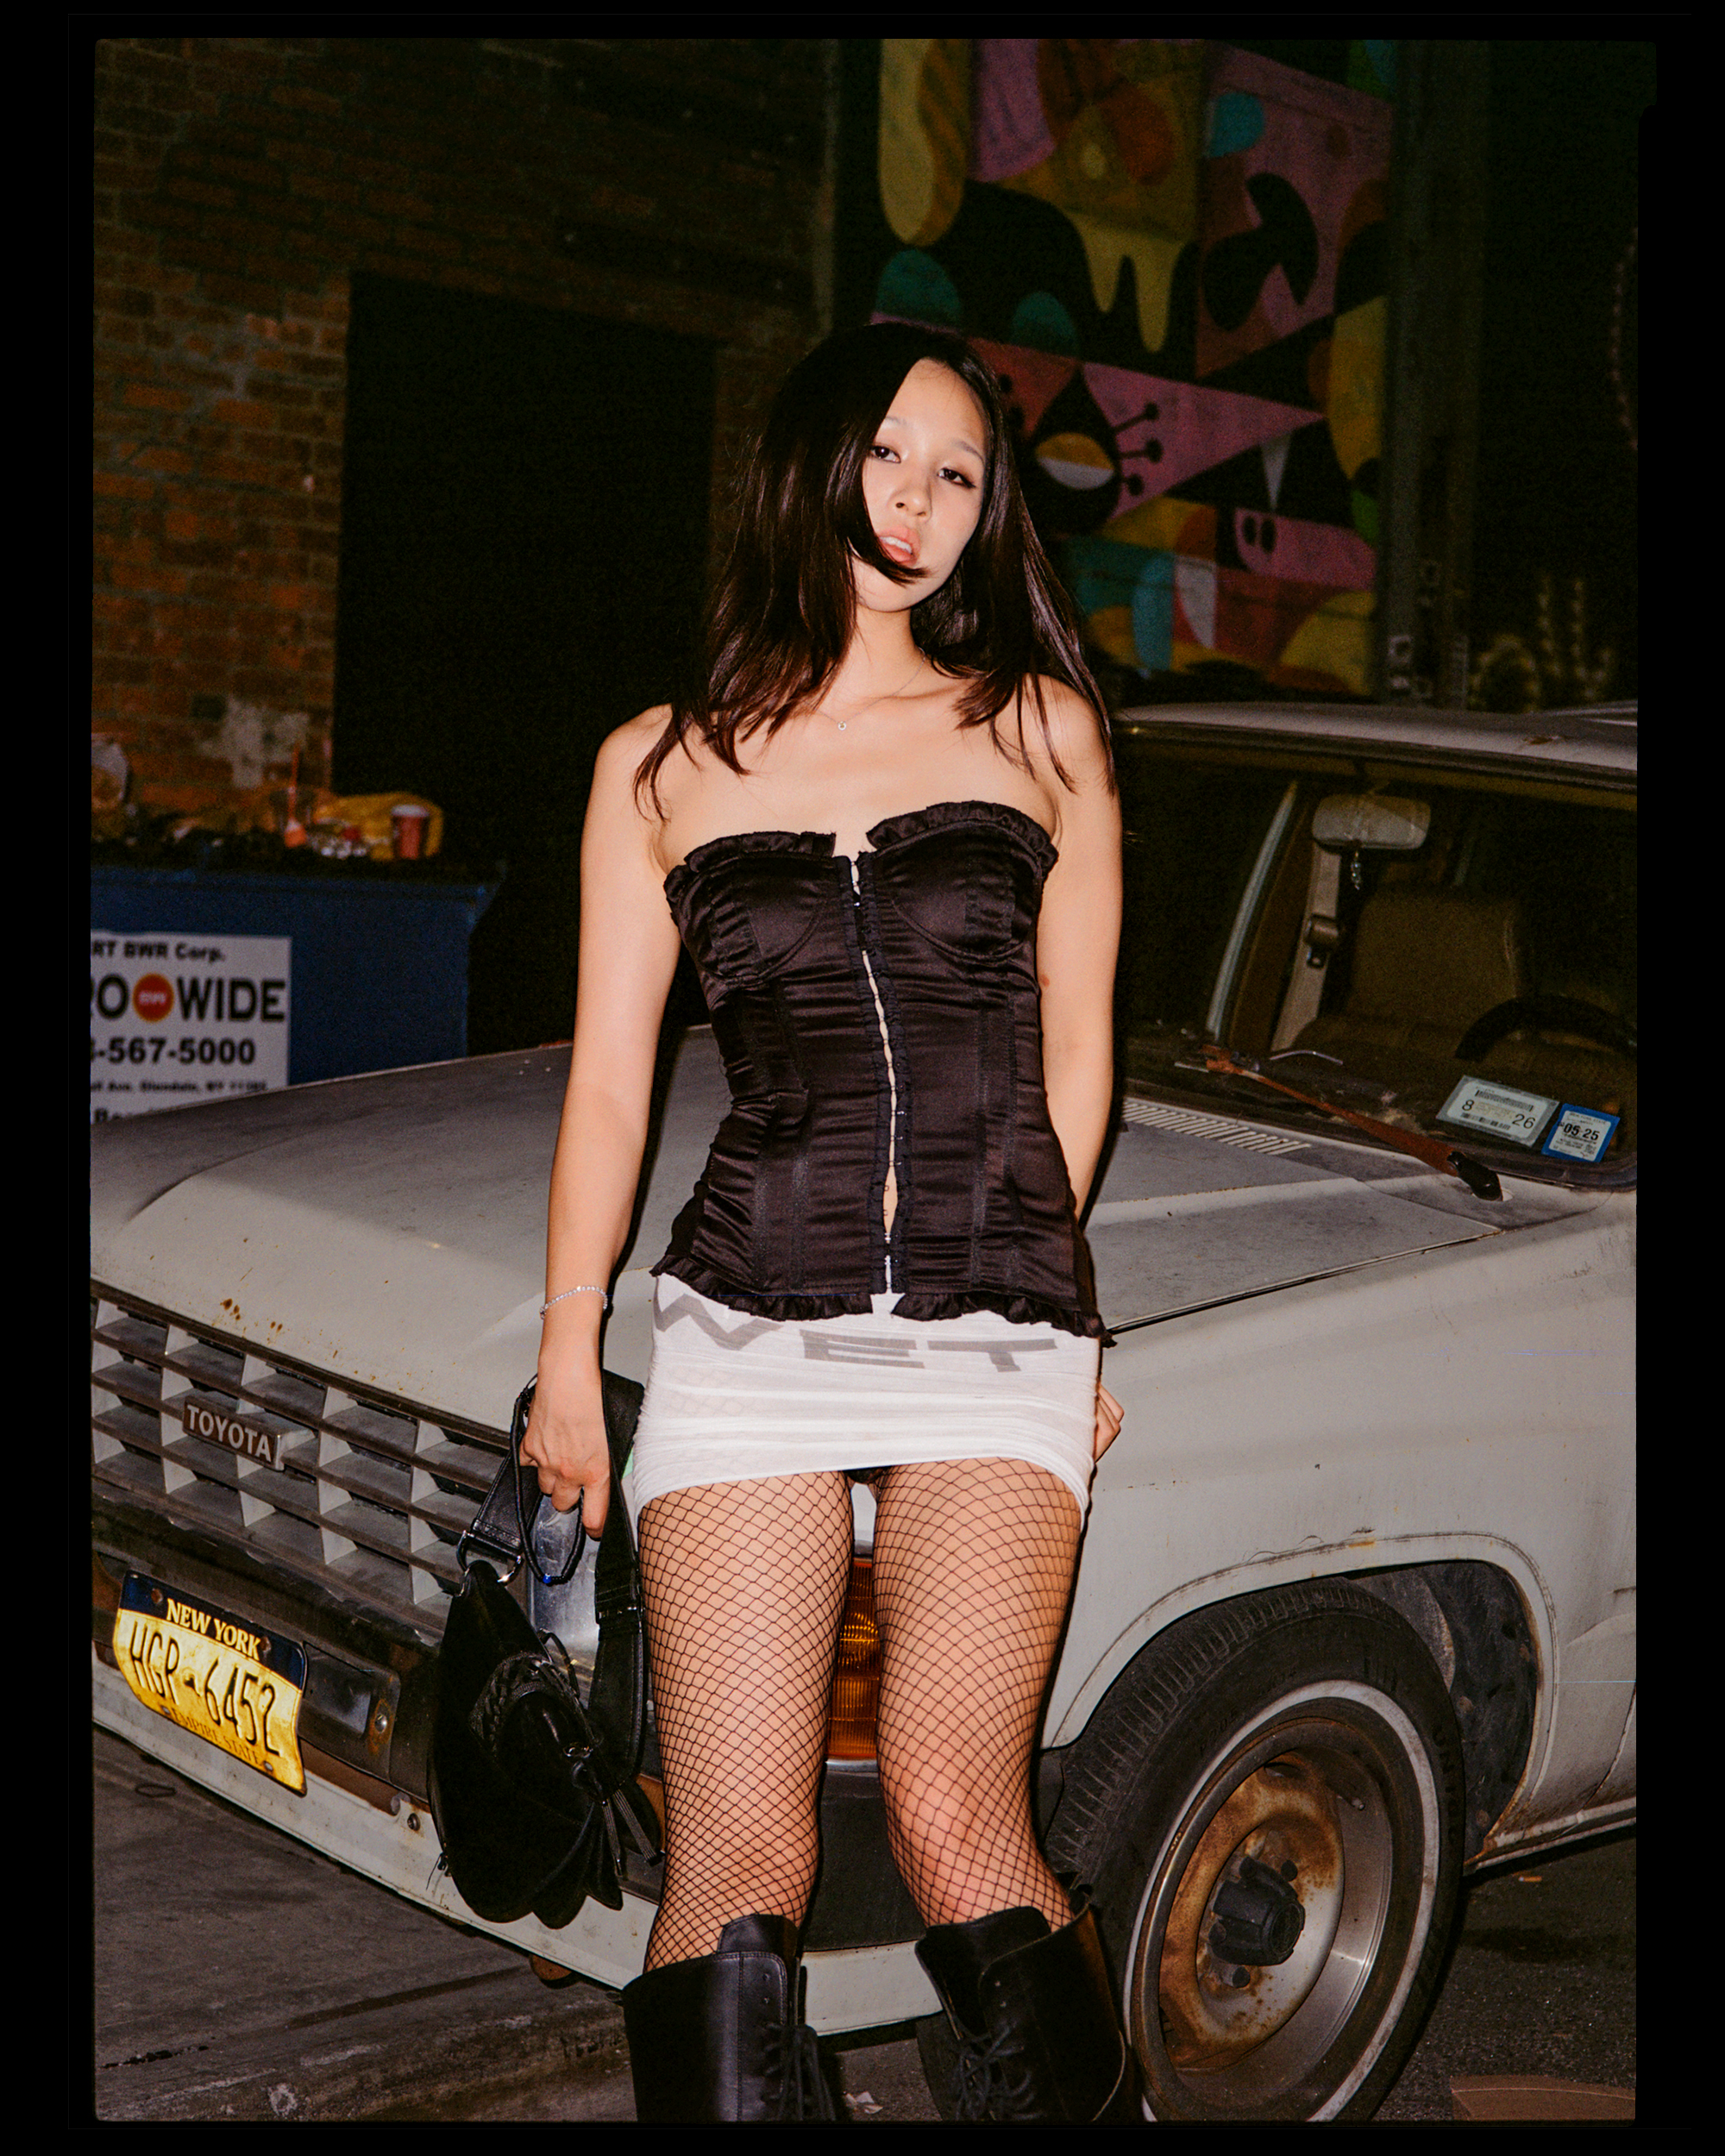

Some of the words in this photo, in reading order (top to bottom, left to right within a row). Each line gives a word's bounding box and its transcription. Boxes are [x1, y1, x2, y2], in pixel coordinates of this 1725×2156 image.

[176, 943, 224, 963] Corp.
[177, 977, 285, 1022] WIDE
[1462, 1099, 1475, 1112] 8
[1511, 1113, 1536, 1129] 26
[186, 1403, 273, 1463] TOYOTA
[166, 1597, 212, 1635] NEW
[212, 1618, 261, 1661] YORK
[204, 1656, 282, 1758] 6452
[171, 1707, 222, 1744] EMPIRE
[223, 1735, 264, 1767] STATE
